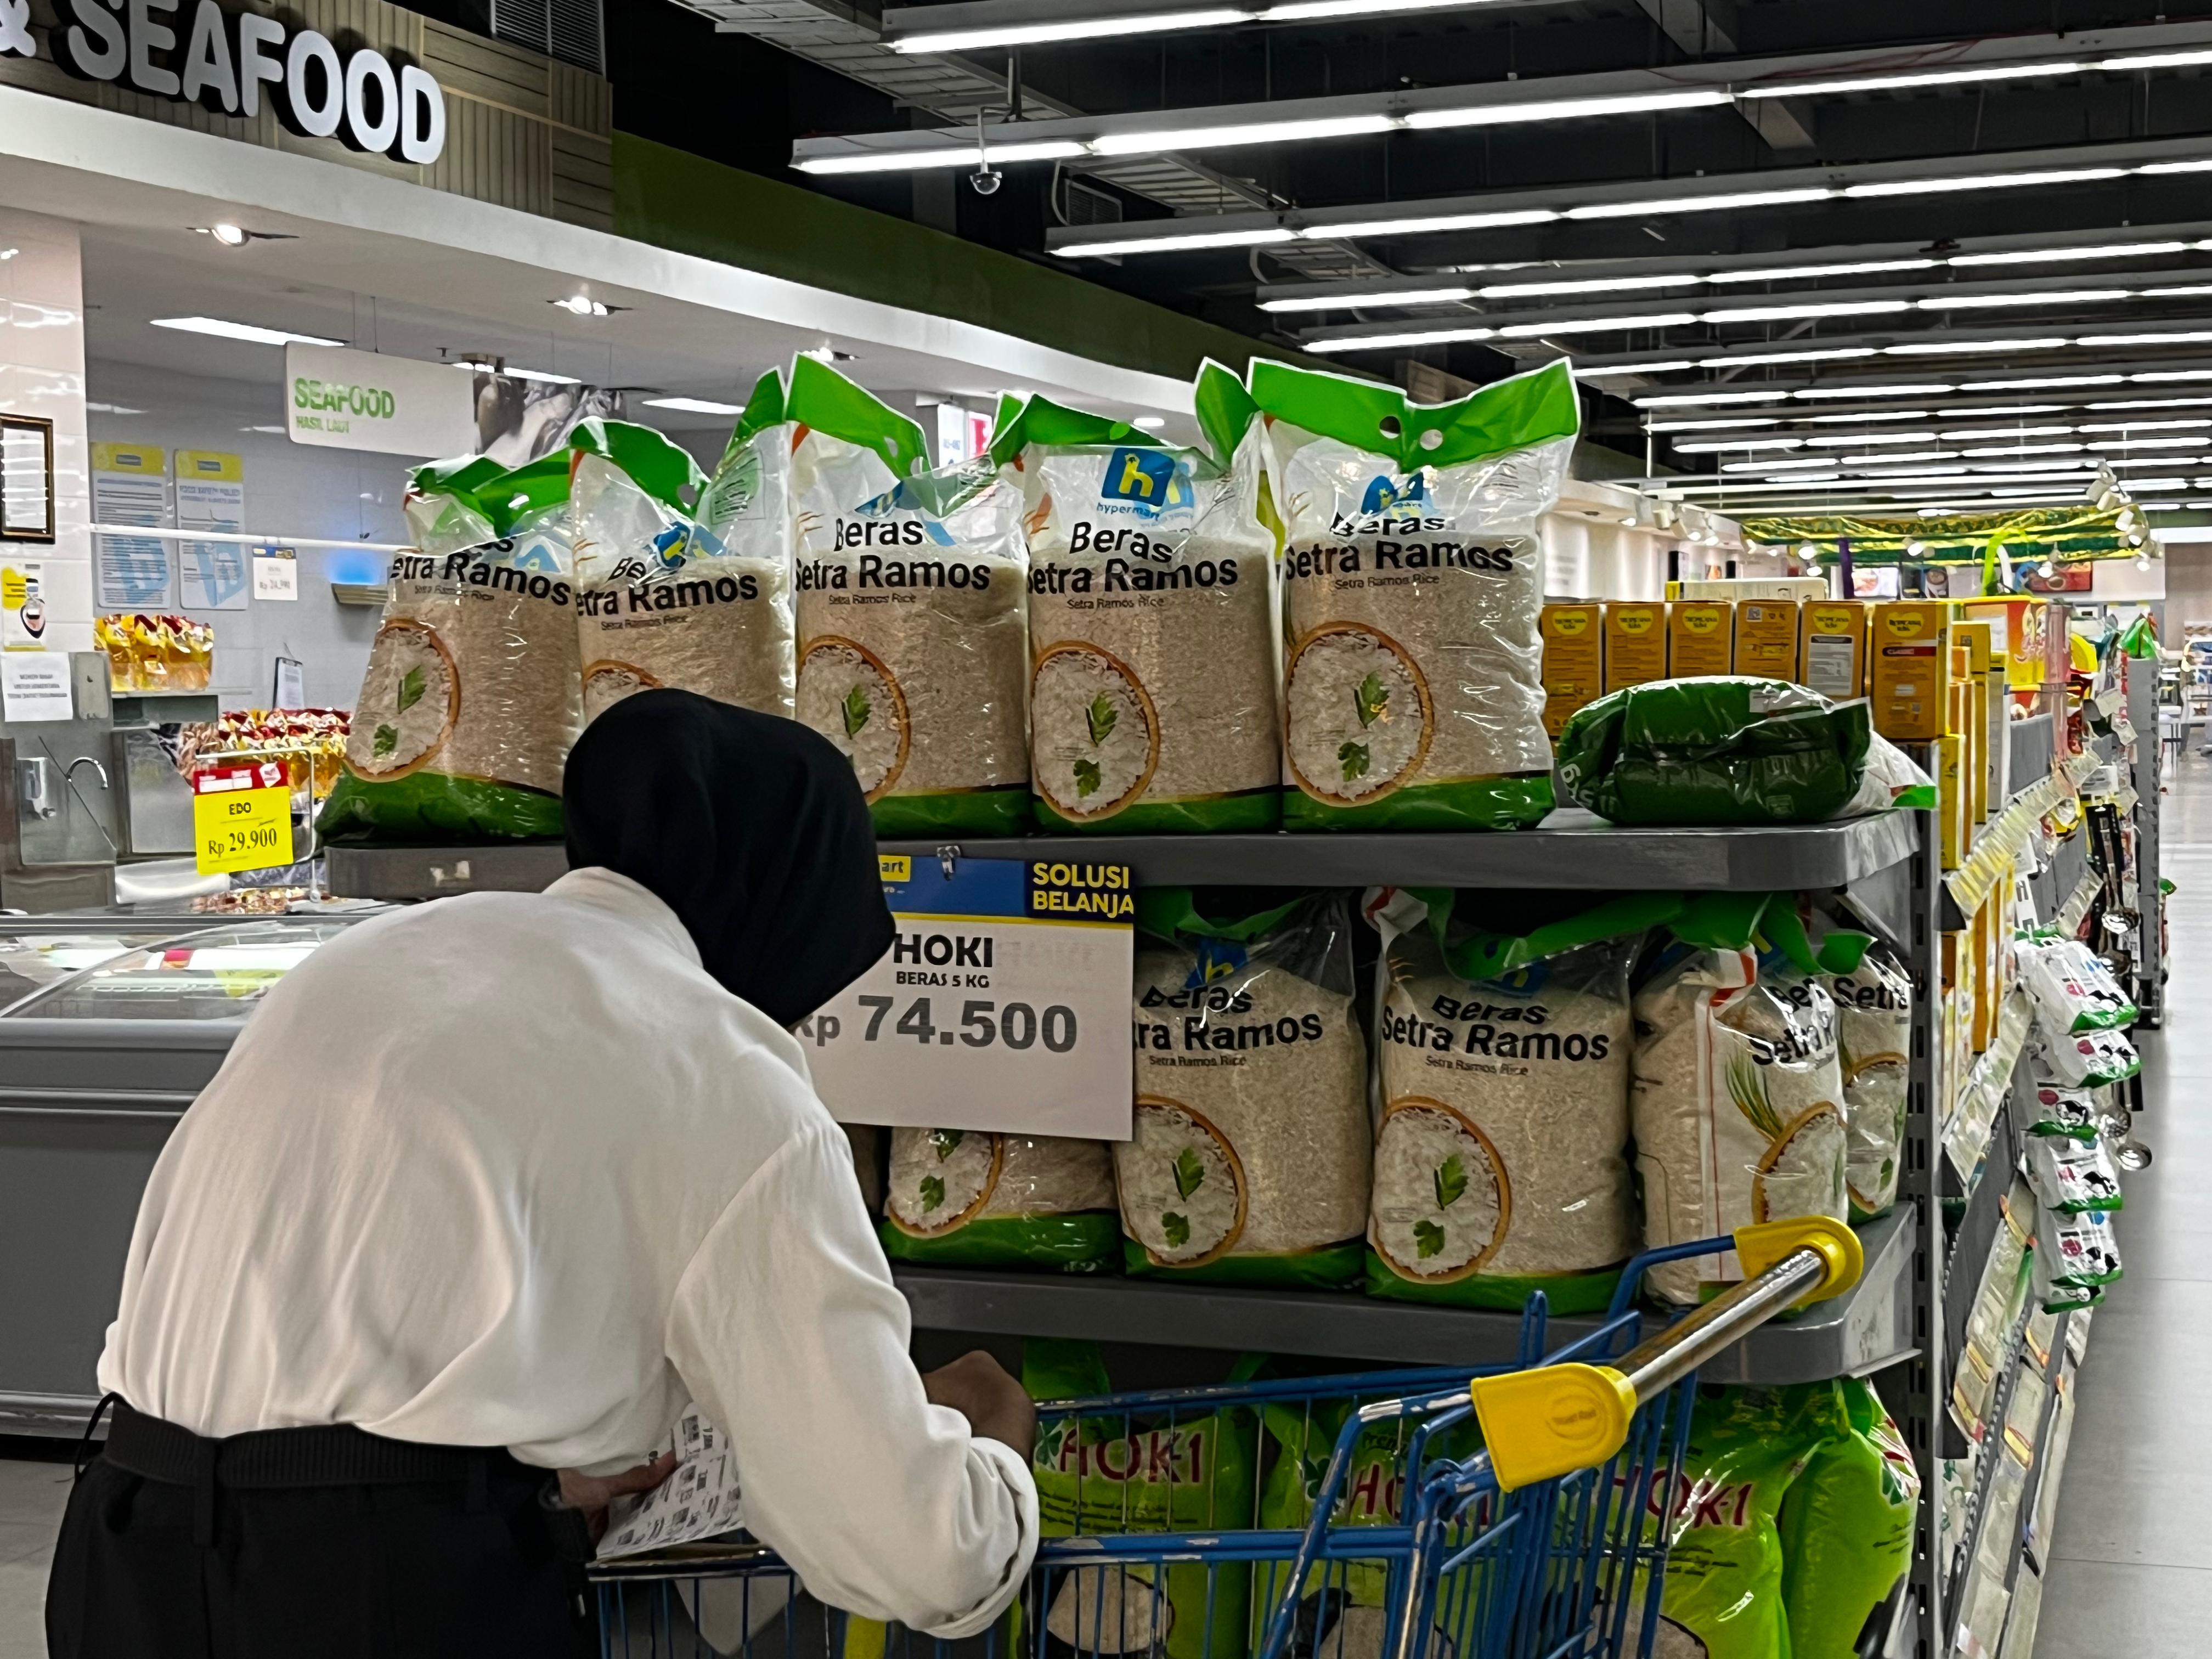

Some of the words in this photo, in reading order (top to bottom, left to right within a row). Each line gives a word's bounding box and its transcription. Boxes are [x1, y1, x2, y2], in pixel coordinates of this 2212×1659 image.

[68, 0, 445, 164] SEAFOOD
[294, 377, 395, 419] SEAFOOD
[833, 518, 923, 552] Beras
[1069, 521, 1173, 563] Beras
[859, 554, 991, 590] Ramos
[1104, 557, 1238, 592] Ramos
[1285, 543, 1361, 580] Setra
[1375, 540, 1513, 572] Ramos
[390, 556, 435, 580] etra
[443, 552, 571, 606] Ramos
[576, 589, 619, 617] etra
[628, 574, 759, 613] Ramos
[229, 802, 252, 815] EDO
[208, 840, 224, 858] Rp
[228, 827, 278, 852] 29.900
[1033, 862, 1130, 889] SOLUSI
[1033, 890, 1134, 919] BELANJA
[893, 934, 994, 968] HOKI
[895, 970, 948, 986] BERAS
[952, 974, 962, 987] 5
[966, 974, 990, 988] KG
[858, 995, 1077, 1053] 74.500
[1431, 994, 1549, 1025] Beras
[1184, 1013, 1323, 1051] Ramos
[1381, 1005, 1454, 1052] Setra
[1465, 1024, 1611, 1062] Ramos
